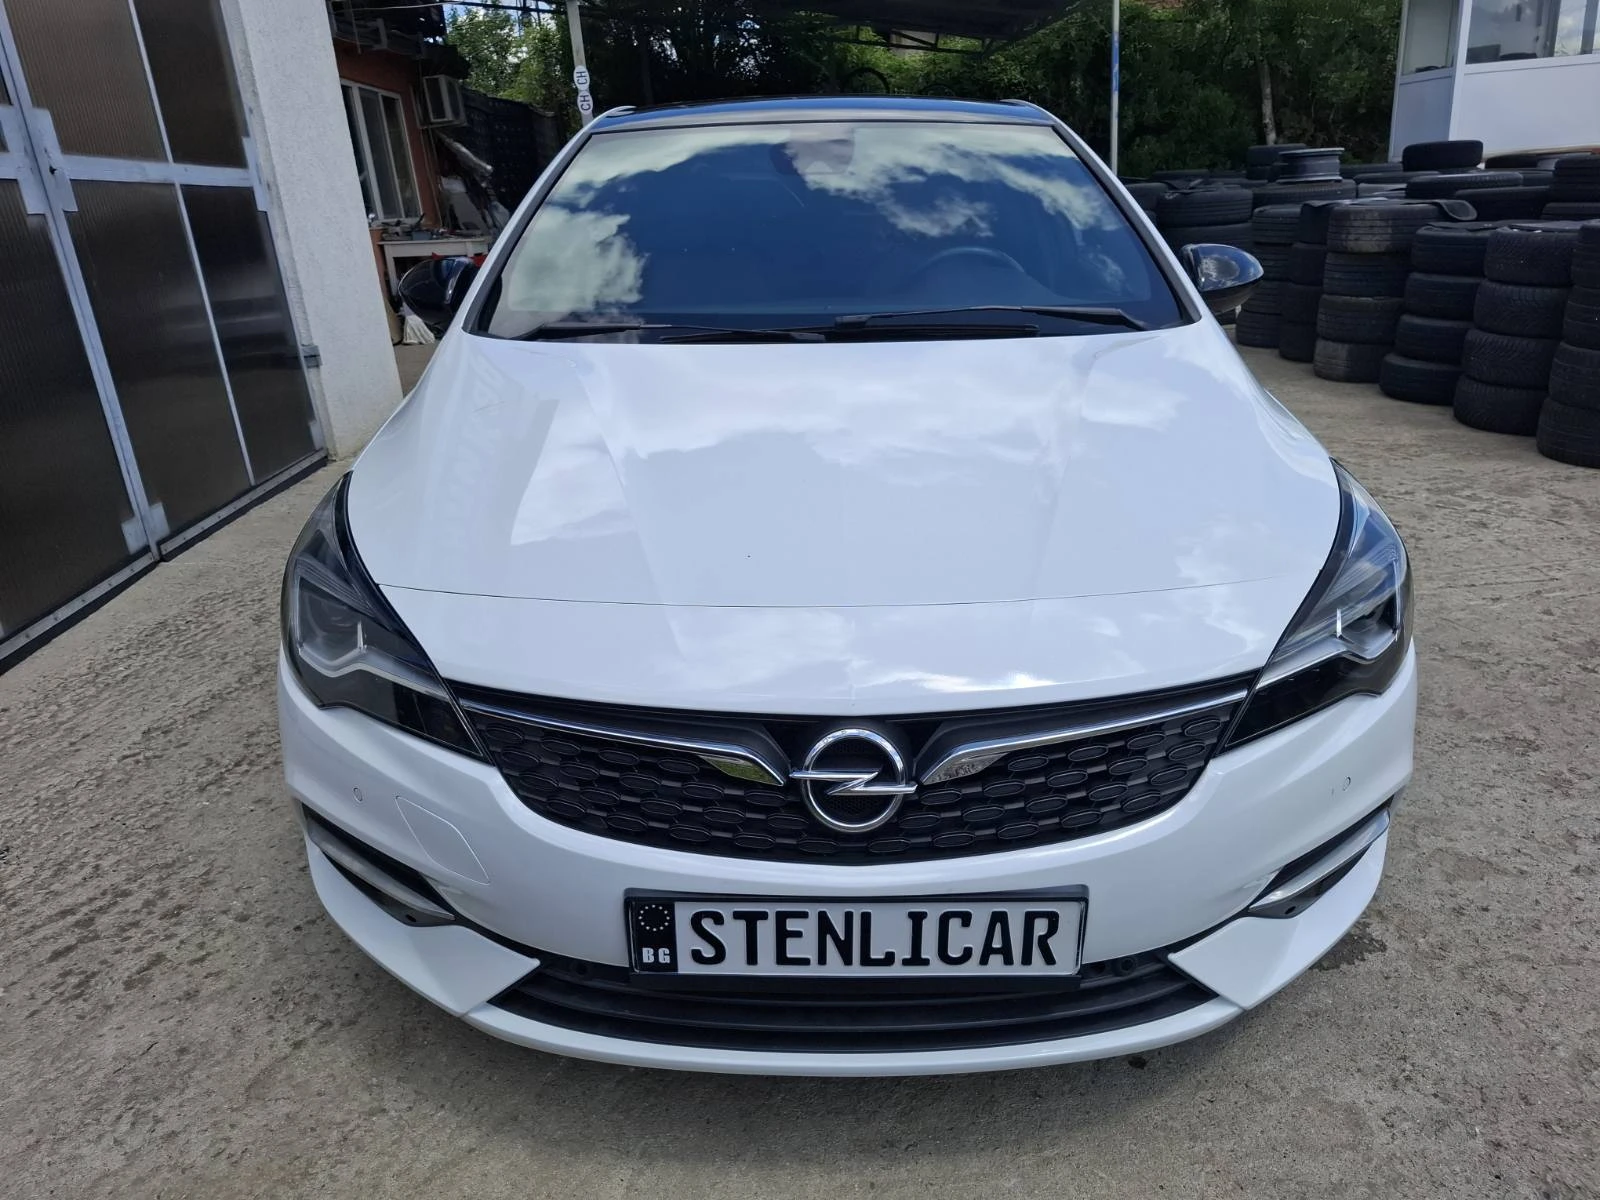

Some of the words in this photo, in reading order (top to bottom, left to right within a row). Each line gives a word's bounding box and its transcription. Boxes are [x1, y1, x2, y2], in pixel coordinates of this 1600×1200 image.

[576, 71, 588, 85] CH
[579, 94, 591, 111] CH
[690, 910, 1060, 966] STENLICAR
[642, 947, 670, 964] BG
